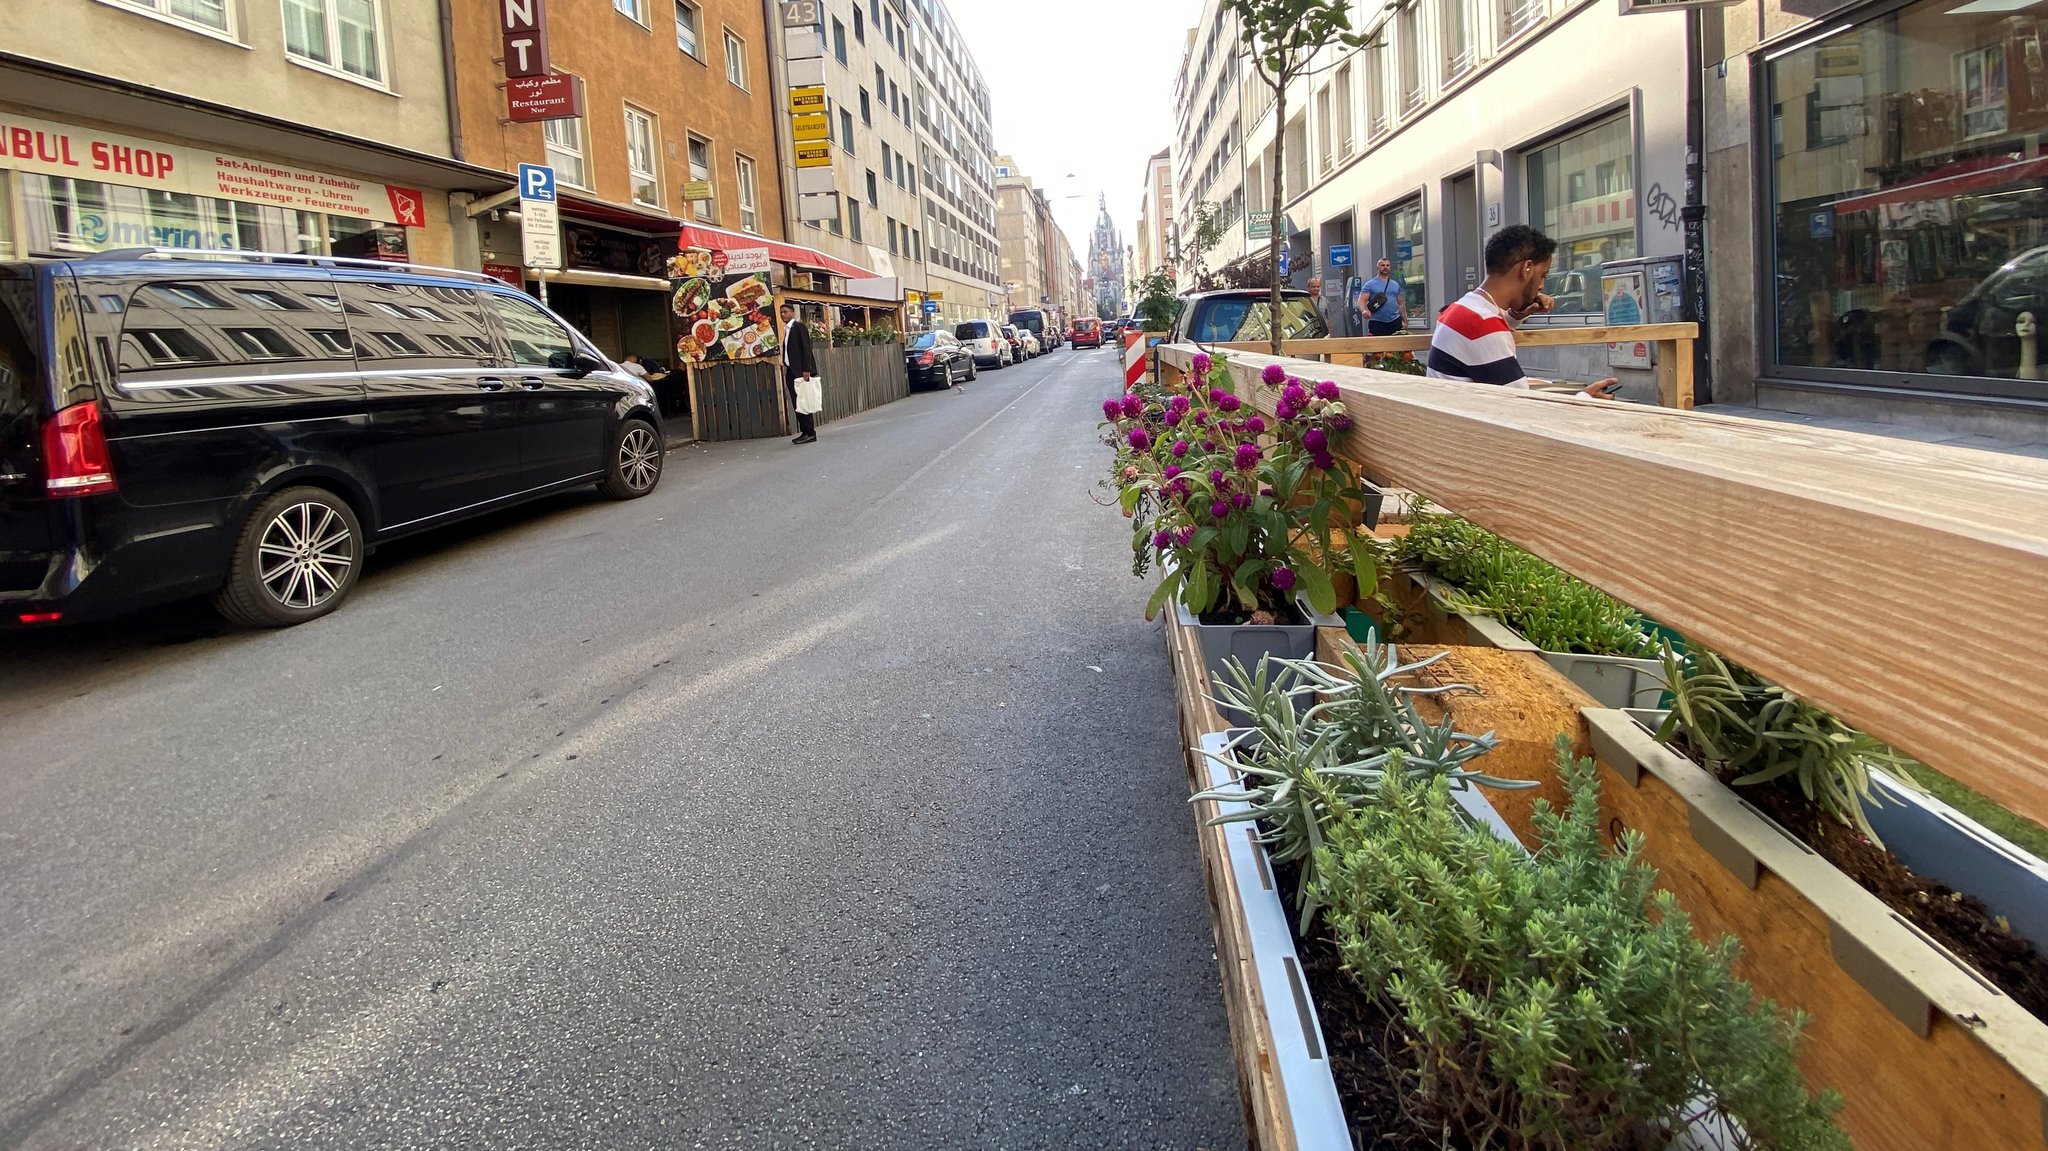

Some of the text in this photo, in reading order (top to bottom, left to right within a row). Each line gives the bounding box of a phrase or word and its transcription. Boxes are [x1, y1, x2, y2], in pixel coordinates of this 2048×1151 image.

[786, 2, 816, 23] 43
[541, 77, 562, 88] مطعم
[512, 97, 566, 108] Restaurant
[92, 141, 174, 180] SHOP
[215, 156, 361, 191] Sat-Anlagen und Zubehör
[216, 171, 312, 195] Haushaltwaren
[322, 189, 353, 202] Uhren
[527, 168, 547, 196] P
[218, 183, 293, 203] Werkzeuge
[304, 197, 370, 215] Feuerzeuge
[1489, 206, 1497, 221] 36
[112, 220, 234, 250] merinos
[1354, 278, 1361, 287] P
